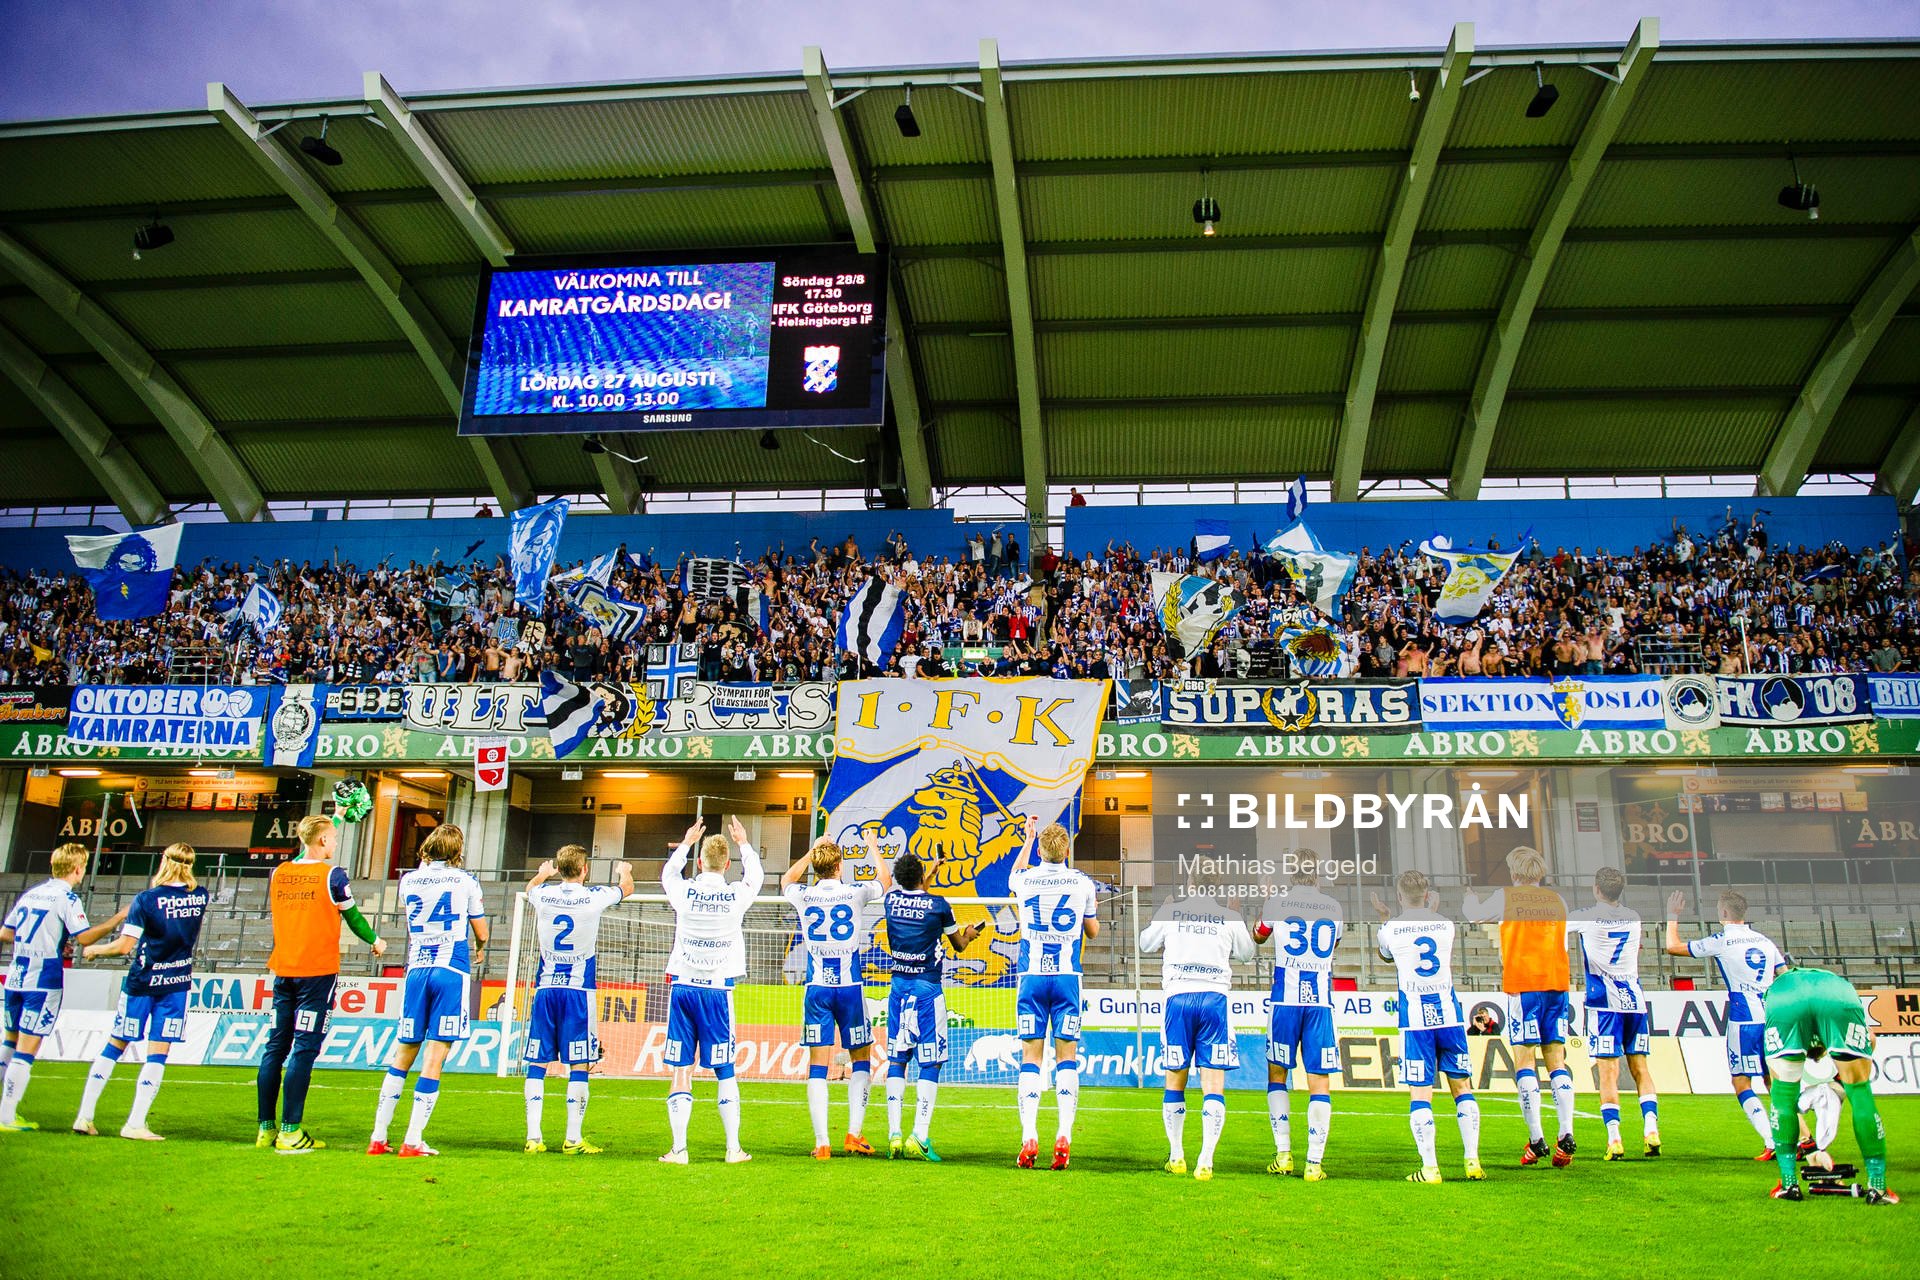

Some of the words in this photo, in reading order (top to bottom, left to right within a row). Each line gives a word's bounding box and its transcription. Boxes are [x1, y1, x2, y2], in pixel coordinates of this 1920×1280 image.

[554, 272, 661, 290] VÄLKOMNA
[666, 271, 703, 286] TILL
[782, 276, 833, 288] Söndag
[836, 275, 865, 285] 28/8
[805, 288, 842, 299] 17.30
[772, 303, 799, 315] IFK
[803, 302, 872, 314] Göteborg
[778, 316, 857, 327] Helsingborgs
[860, 315, 873, 324] IF
[520, 373, 599, 392] LÖRDAG
[604, 373, 625, 389] 27
[631, 371, 716, 388] AUGUSTI
[552, 395, 574, 408] KL.
[643, 413, 692, 424] SAMSUNG
[685, 645, 695, 658] 3
[682, 681, 694, 694] 2
[717, 688, 752, 698] SYMPATI
[753, 687, 770, 698] FÖR
[1185, 681, 1205, 691] GBG
[1875, 680, 1920, 706] BRI
[76, 689, 197, 714] OKTOBER
[716, 697, 724, 706] DE
[1422, 693, 1554, 712] SEKTION
[1585, 689, 1660, 709] OSLO
[68, 718, 250, 745] KAMRATERNA
[316, 734, 379, 758] BRO
[1098, 734, 1168, 757] BRO
[278, 874, 320, 885] Kappa
[407, 876, 461, 886] EHRENBORG
[1024, 878, 1079, 886] EHRENBORG
[157, 894, 206, 909] Prioritet
[540, 895, 591, 905] EHRENBORG
[687, 888, 736, 901] Prioritet
[803, 892, 853, 903] EHRENBORG
[888, 893, 933, 910] Prioritet
[166, 906, 201, 919] Finans
[406, 891, 460, 933] 24
[691, 901, 730, 913] Finans
[891, 905, 925, 919] Finans
[1024, 894, 1076, 932] 16
[1281, 900, 1337, 912] EHRENBORG
[804, 904, 854, 942] 28
[1172, 910, 1225, 926] Prioritet
[15, 908, 49, 943] 27
[552, 914, 574, 951] 2
[1178, 922, 1218, 936] Finans
[1394, 924, 1447, 935] EHRENBORG
[683, 937, 732, 948] EHRENBORG
[1283, 915, 1336, 959] 30
[1608, 931, 1630, 966] 7
[1413, 936, 1441, 977] 3
[1745, 947, 1766, 982] 9
[1100, 998, 1160, 1014] Gunna
[1344, 998, 1372, 1014] AB
